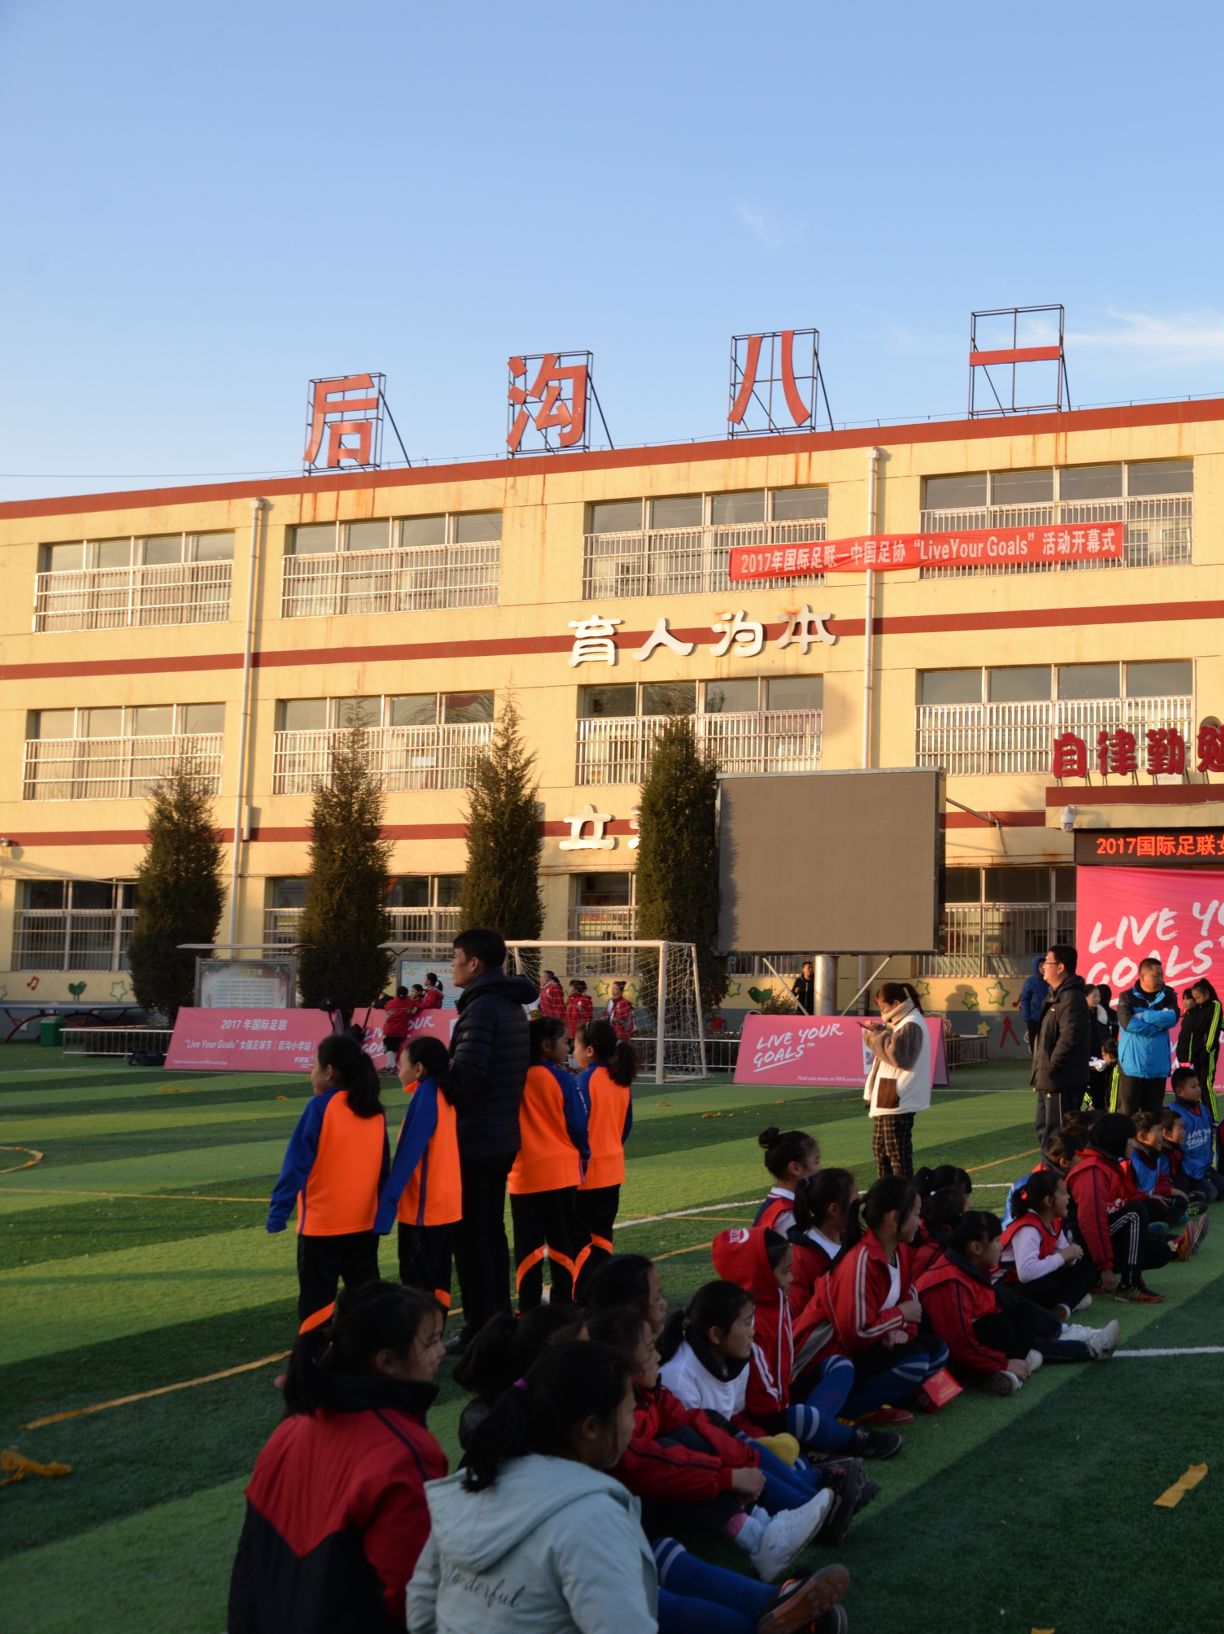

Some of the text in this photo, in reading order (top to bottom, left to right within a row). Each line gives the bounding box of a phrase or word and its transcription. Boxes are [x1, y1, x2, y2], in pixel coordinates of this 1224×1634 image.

[1043, 528, 1116, 555] 活动开幕式
[568, 604, 837, 668] 育人为本
[1088, 907, 1178, 954] LIVE
[1087, 939, 1214, 988] GOLS
[219, 1019, 242, 1030] 2017
[756, 1023, 844, 1049] LIVE YOUR
[753, 1045, 805, 1068] GOALS
